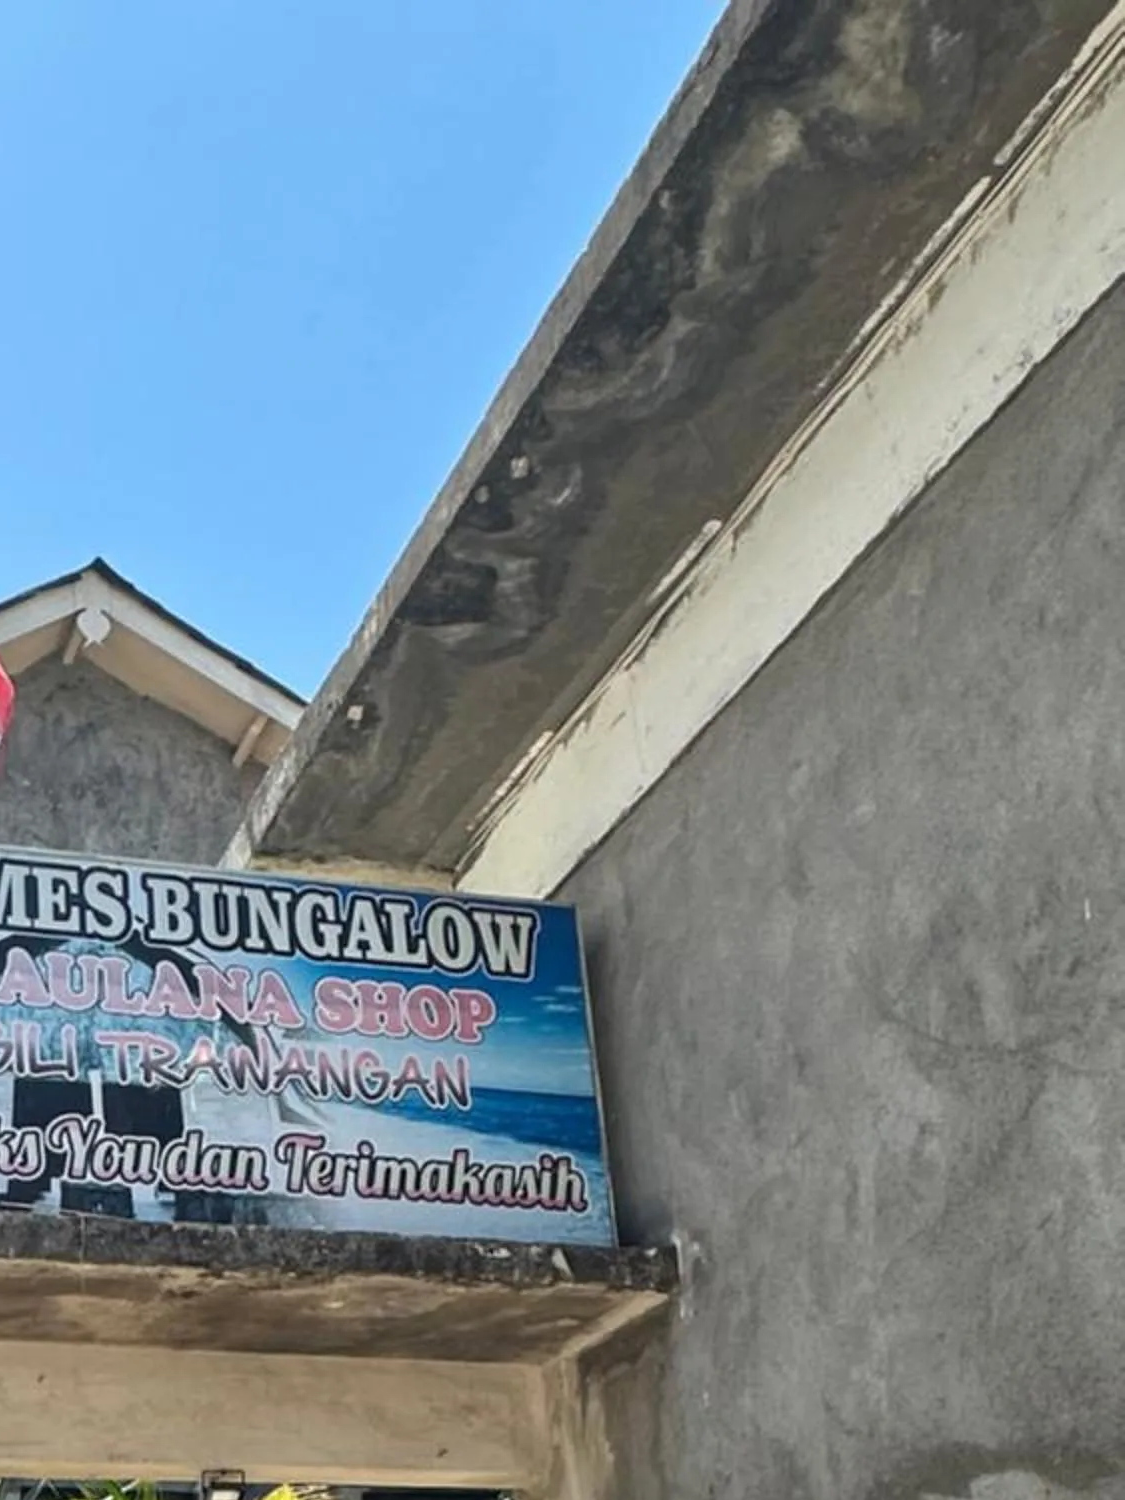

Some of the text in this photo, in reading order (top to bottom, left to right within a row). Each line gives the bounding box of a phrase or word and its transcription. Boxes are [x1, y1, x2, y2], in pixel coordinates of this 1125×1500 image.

[144, 876, 537, 977] BUNGALOW
[313, 974, 496, 1043] SHOP
[96, 1030, 472, 1109] TRAWANGAN
[47, 1112, 157, 1184] You
[163, 1128, 268, 1194] dan
[275, 1132, 588, 1213] Terimakasih
